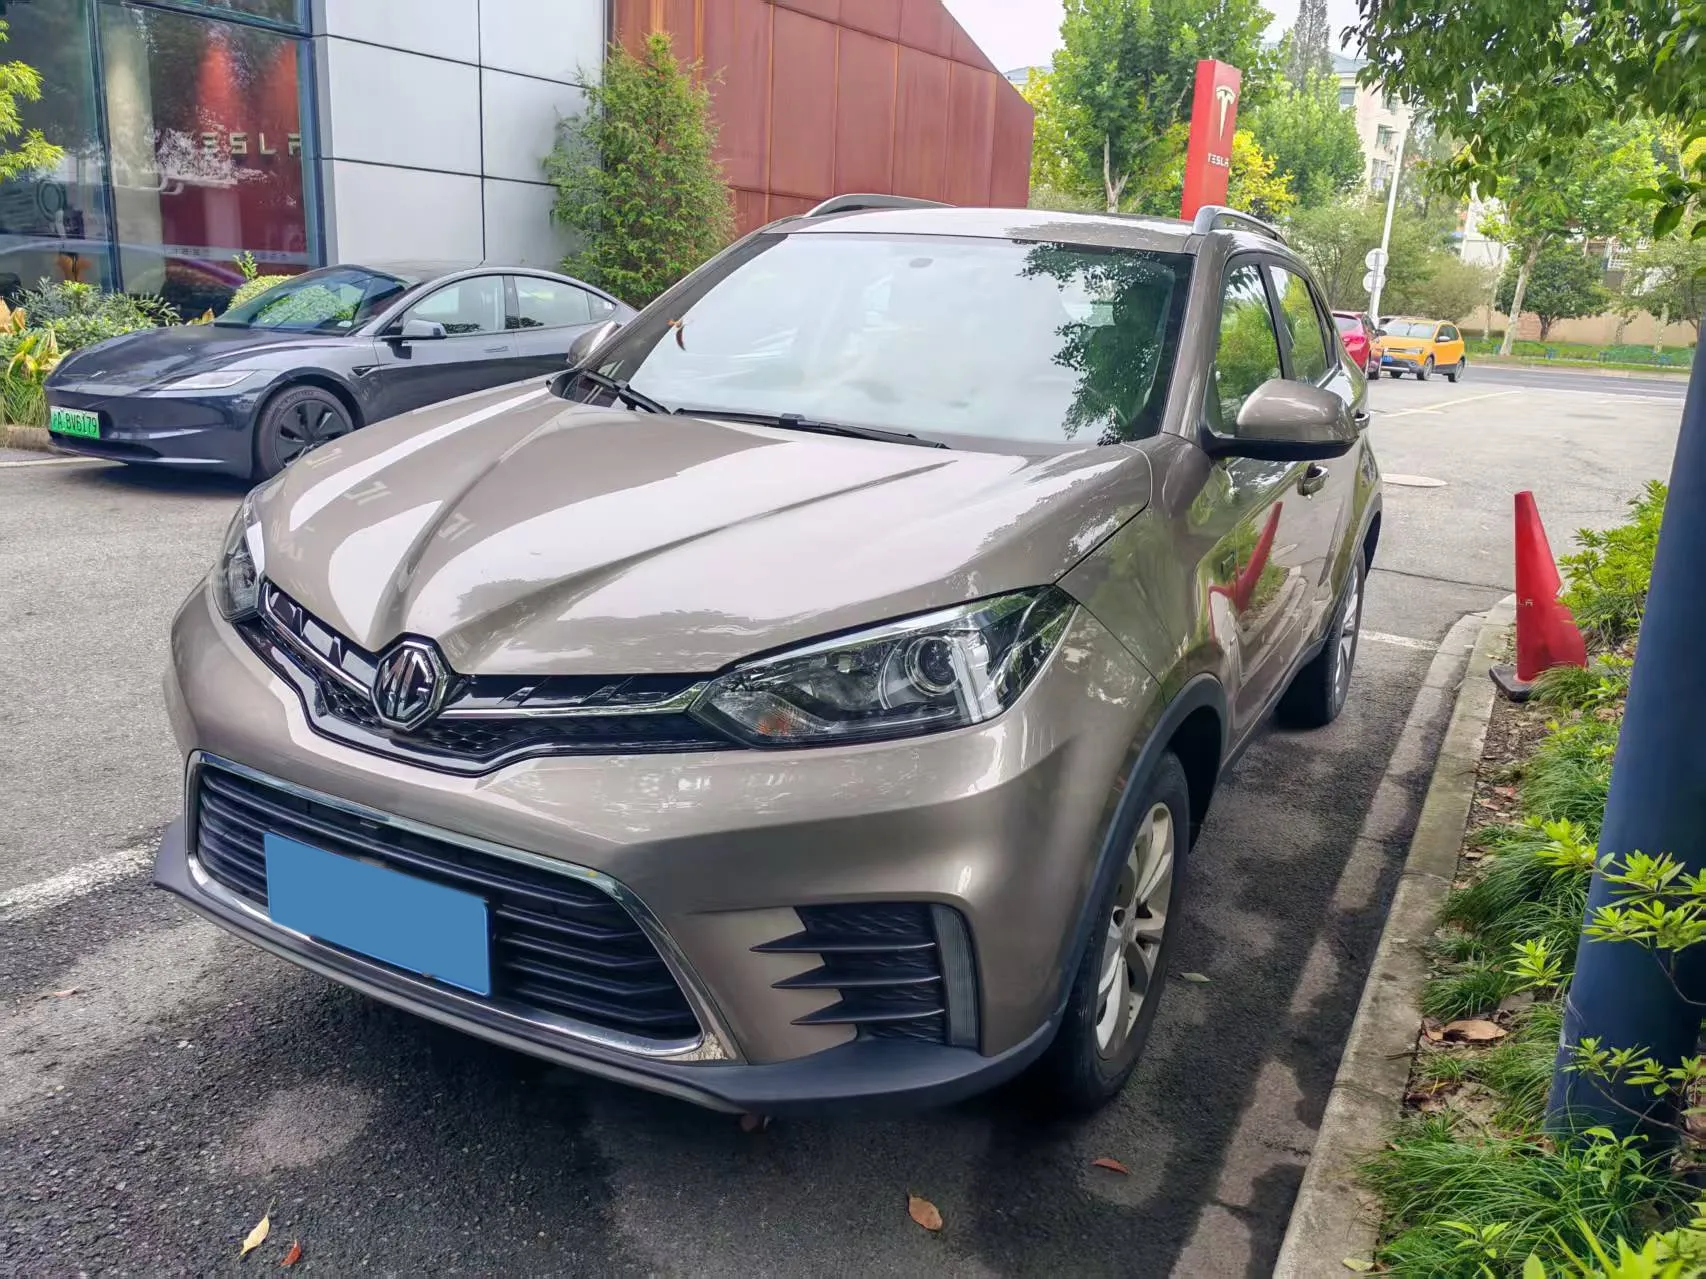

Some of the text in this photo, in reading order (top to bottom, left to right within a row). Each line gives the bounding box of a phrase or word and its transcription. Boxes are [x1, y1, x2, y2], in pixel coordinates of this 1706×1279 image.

[202, 132, 300, 156] ESLA
[1208, 152, 1229, 168] TESLA
[380, 649, 433, 718] MG
